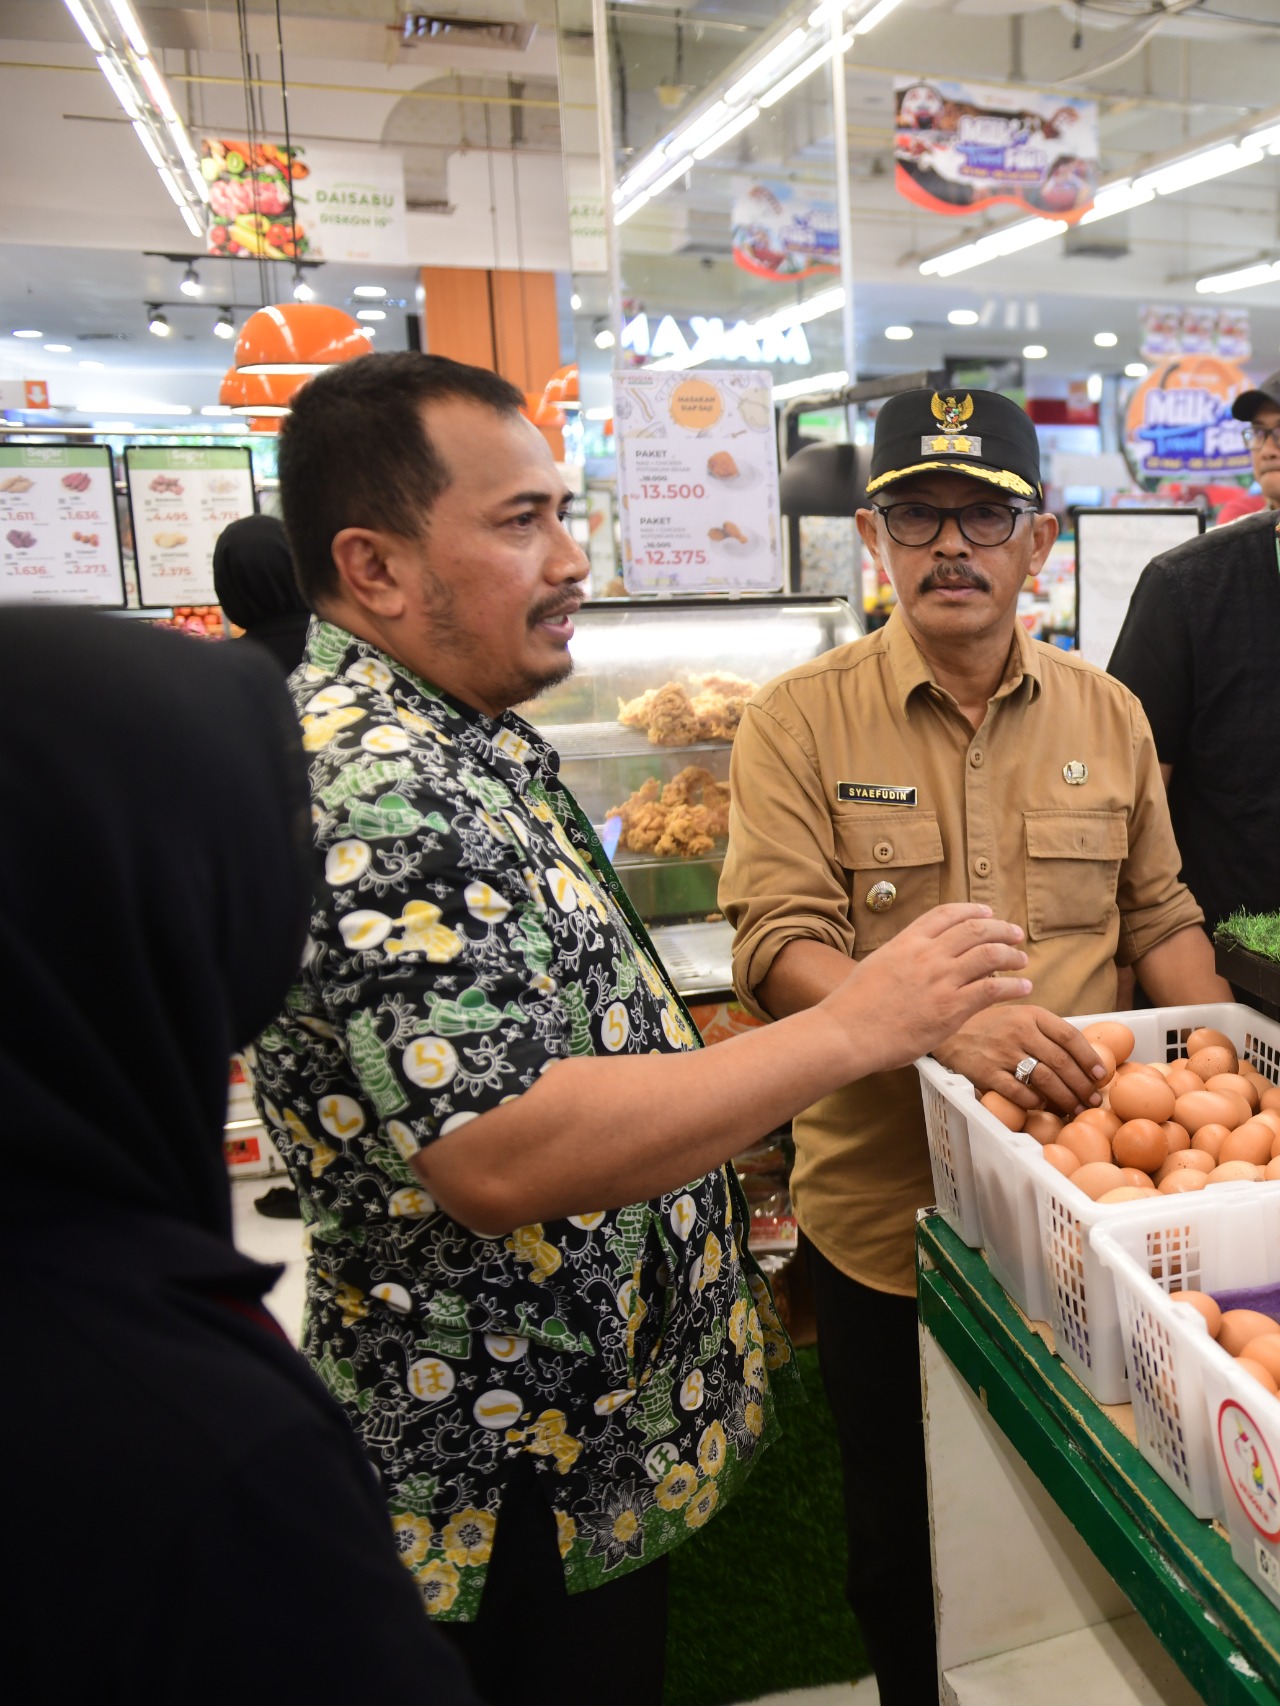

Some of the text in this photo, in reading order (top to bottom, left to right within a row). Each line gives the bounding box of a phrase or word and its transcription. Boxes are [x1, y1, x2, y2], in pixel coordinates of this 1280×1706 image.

[635, 450, 668, 458] PAKET
[640, 484, 705, 500] 13.500
[640, 517, 671, 525] PAKET
[645, 549, 707, 566] 12.375
[849, 788, 907, 801] SYAEFUDIN
